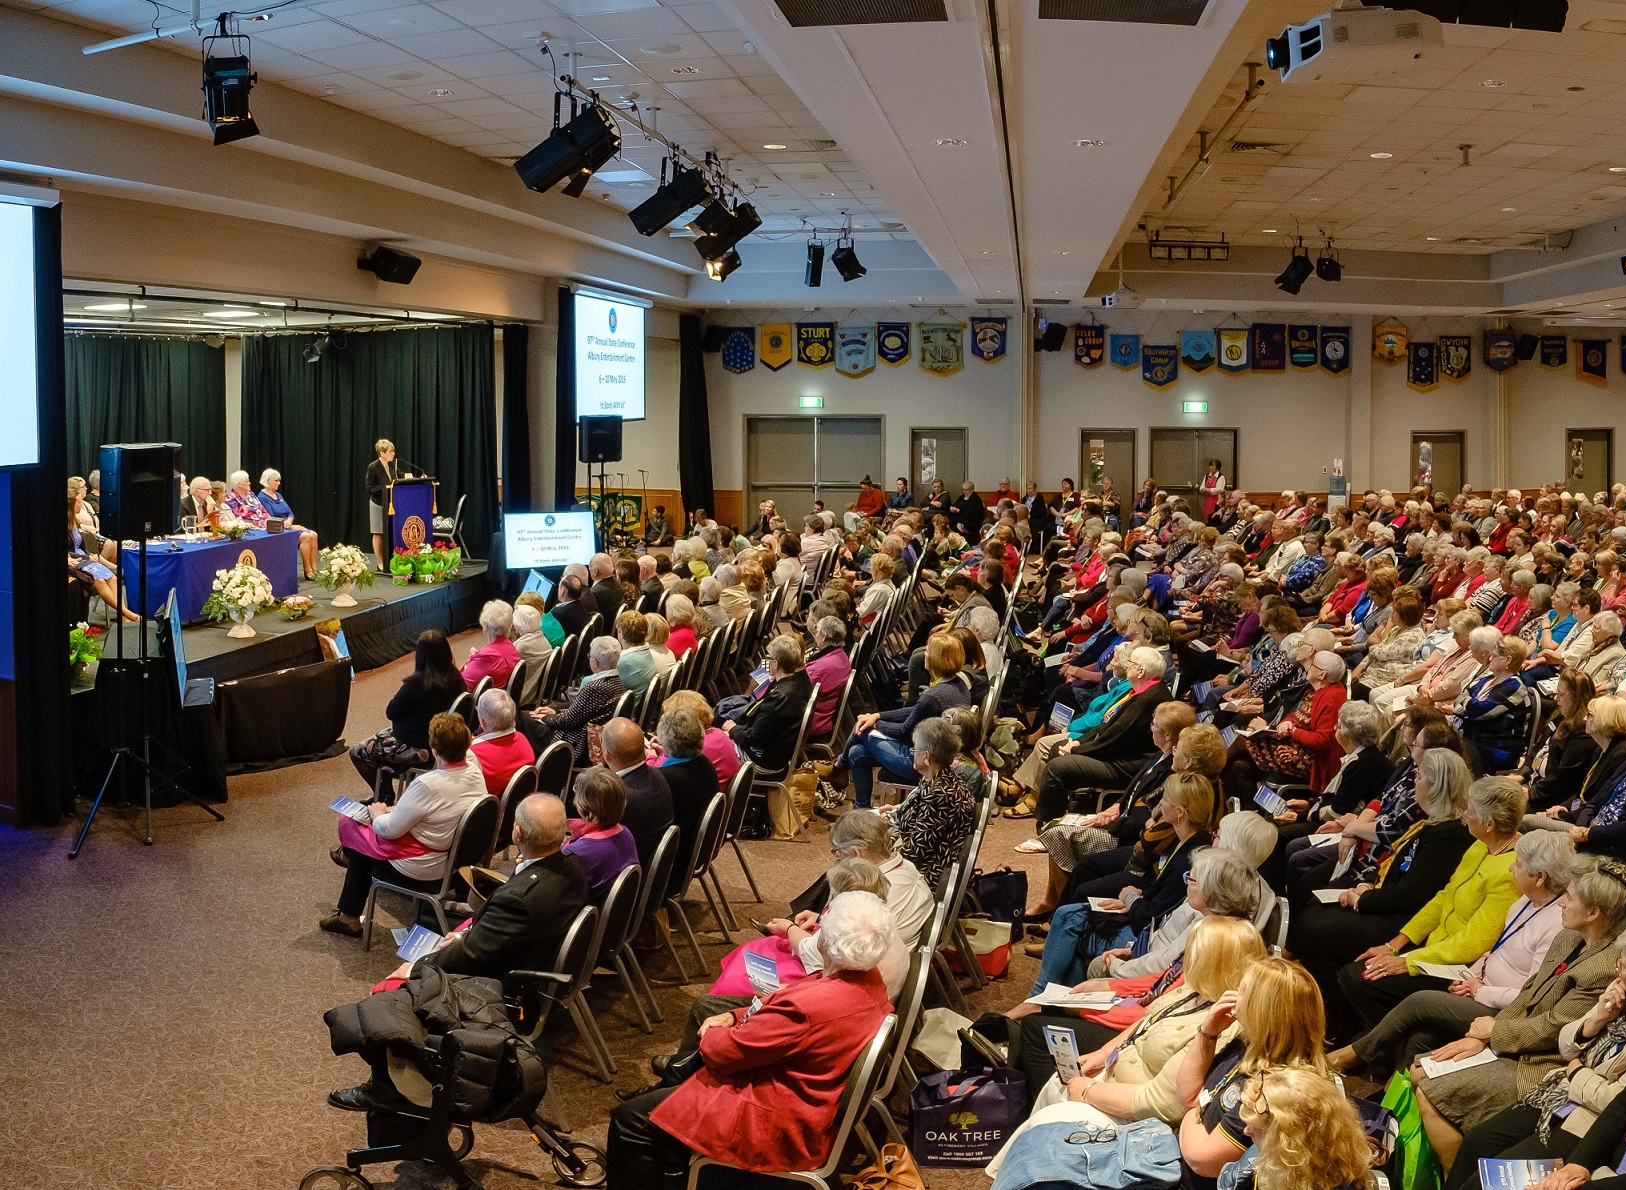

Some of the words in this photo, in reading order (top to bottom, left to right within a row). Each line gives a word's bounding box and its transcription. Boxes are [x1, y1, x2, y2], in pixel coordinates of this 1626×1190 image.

[800, 328, 830, 338] STURT
[596, 337, 608, 346] Annual
[608, 338, 617, 347] State
[618, 339, 635, 349] Conference
[588, 351, 600, 363] Albury
[601, 352, 624, 362] Entertainment
[625, 353, 635, 362] Centre
[723, 364, 754, 373] COUNTRY
[926, 1131, 958, 1141] OAK
[963, 1130, 1001, 1141] TREE
[1506, 1161, 1514, 1178] Meeting
